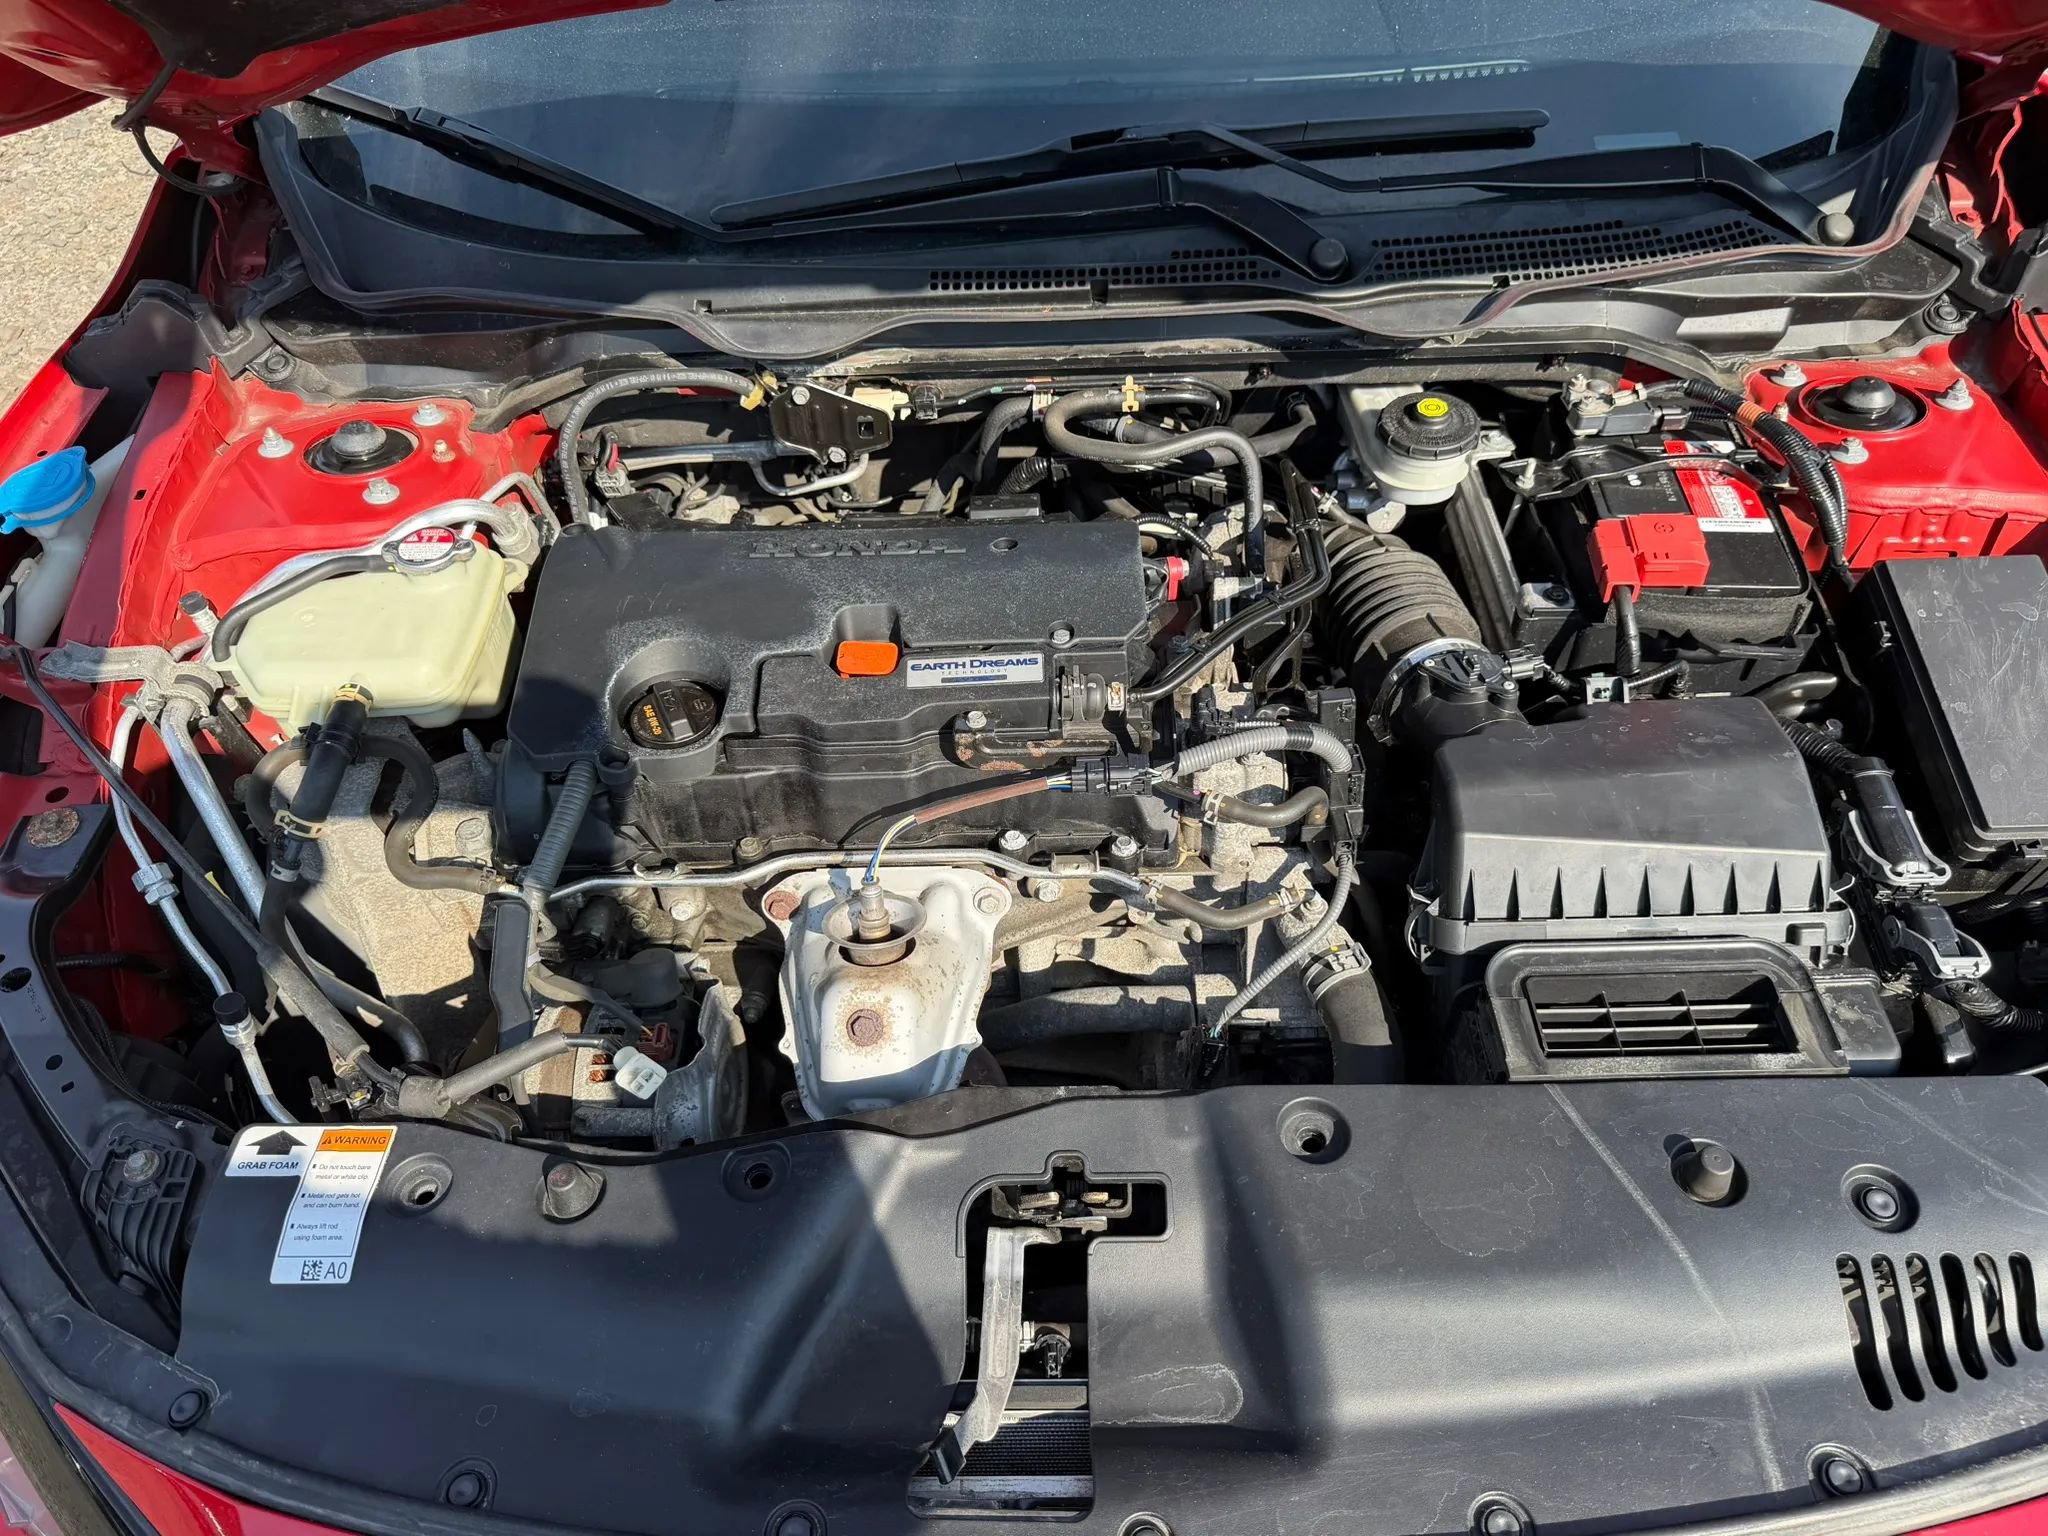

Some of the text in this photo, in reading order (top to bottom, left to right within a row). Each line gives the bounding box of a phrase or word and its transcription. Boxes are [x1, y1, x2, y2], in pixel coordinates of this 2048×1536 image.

[749, 538, 967, 558] HONDA
[910, 657, 1039, 671] EARTH DREAMS
[642, 704, 656, 718] SAE
[334, 1135, 387, 1145] WARNING
[237, 1161, 299, 1170] GRAB FOAM
[293, 1234, 310, 1242] using
[324, 1261, 347, 1280] A0
